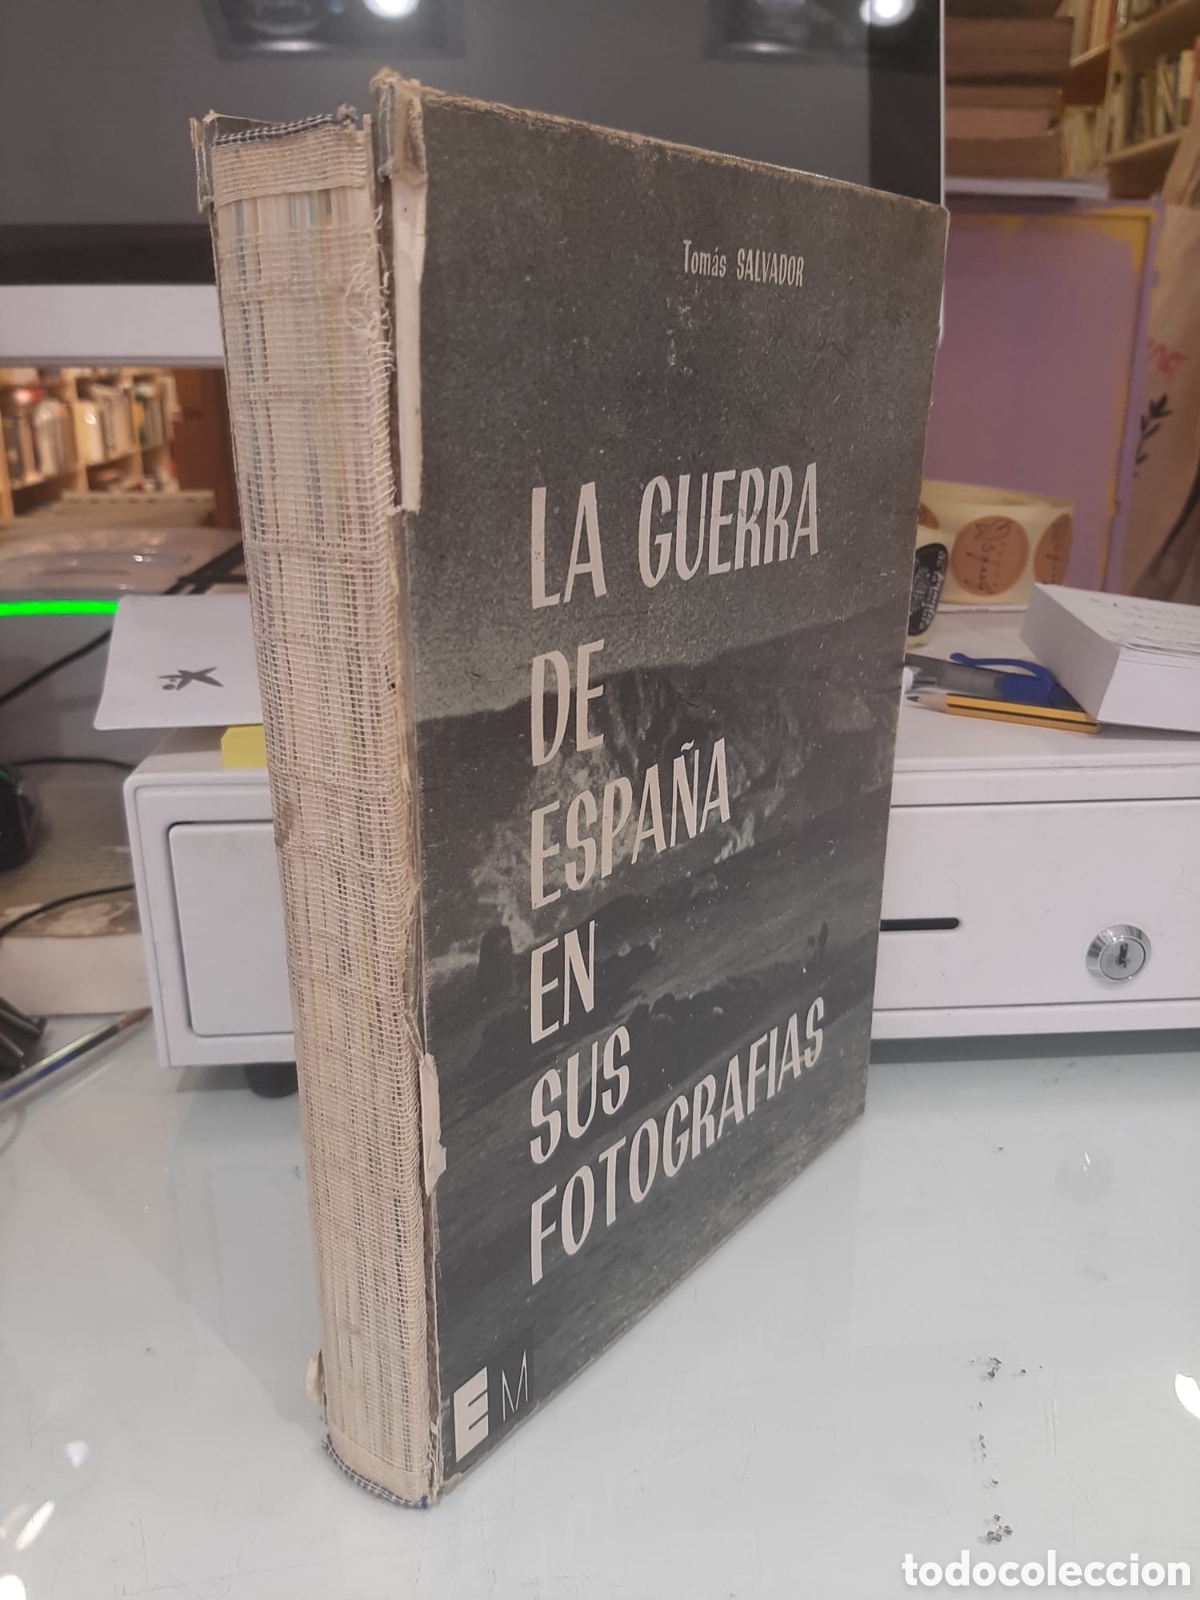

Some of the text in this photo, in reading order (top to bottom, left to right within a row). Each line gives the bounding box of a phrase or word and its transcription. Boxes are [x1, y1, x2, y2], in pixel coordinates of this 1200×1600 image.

[683, 239, 805, 287] Tomás SALVADOR
[531, 481, 607, 610] LA
[638, 461, 819, 588] GUERRA
[531, 639, 605, 767] DE
[531, 737, 731, 910] ESPAÑA
[531, 919, 596, 1044] EN
[530, 1025, 631, 1164] SUS
[530, 996, 825, 1285] FOTOGRAFIAS
